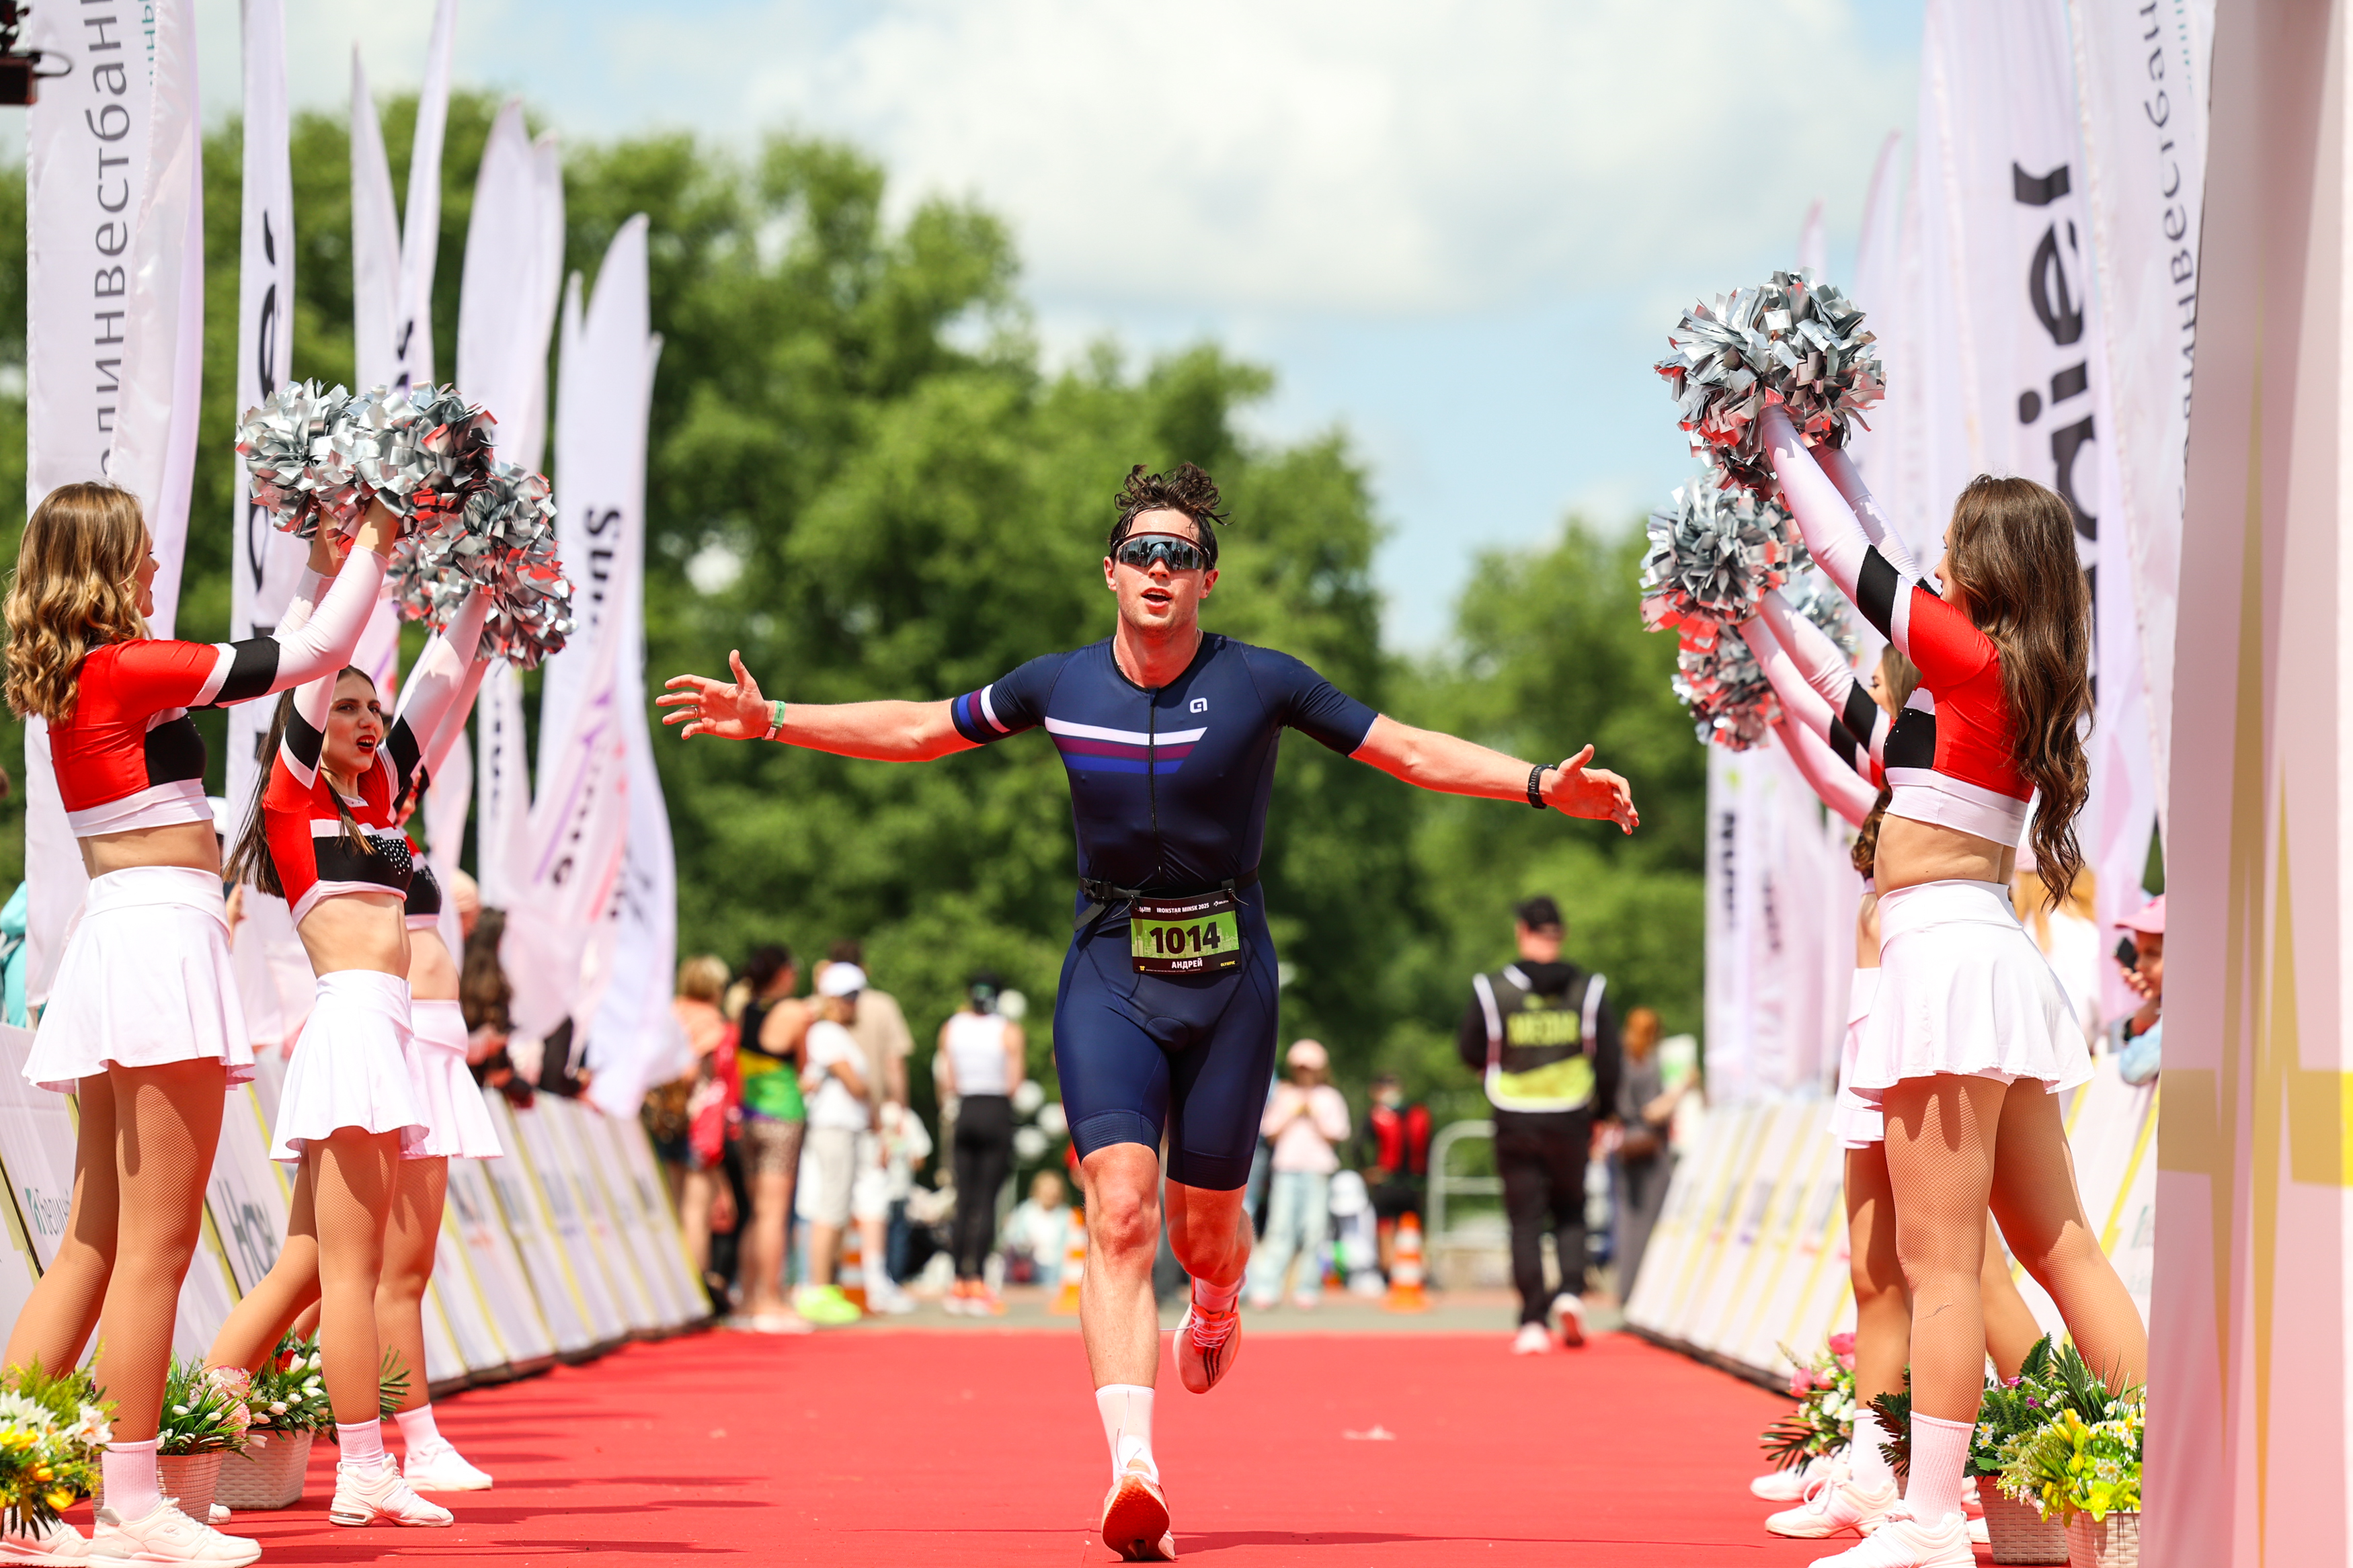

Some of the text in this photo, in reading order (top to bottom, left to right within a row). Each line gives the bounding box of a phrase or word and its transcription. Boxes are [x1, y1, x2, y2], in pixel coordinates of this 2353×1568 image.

[1182, 905, 1197, 913] MINSK
[1149, 921, 1220, 954] 1014
[1171, 957, 1203, 970] АНДРЕЙ
